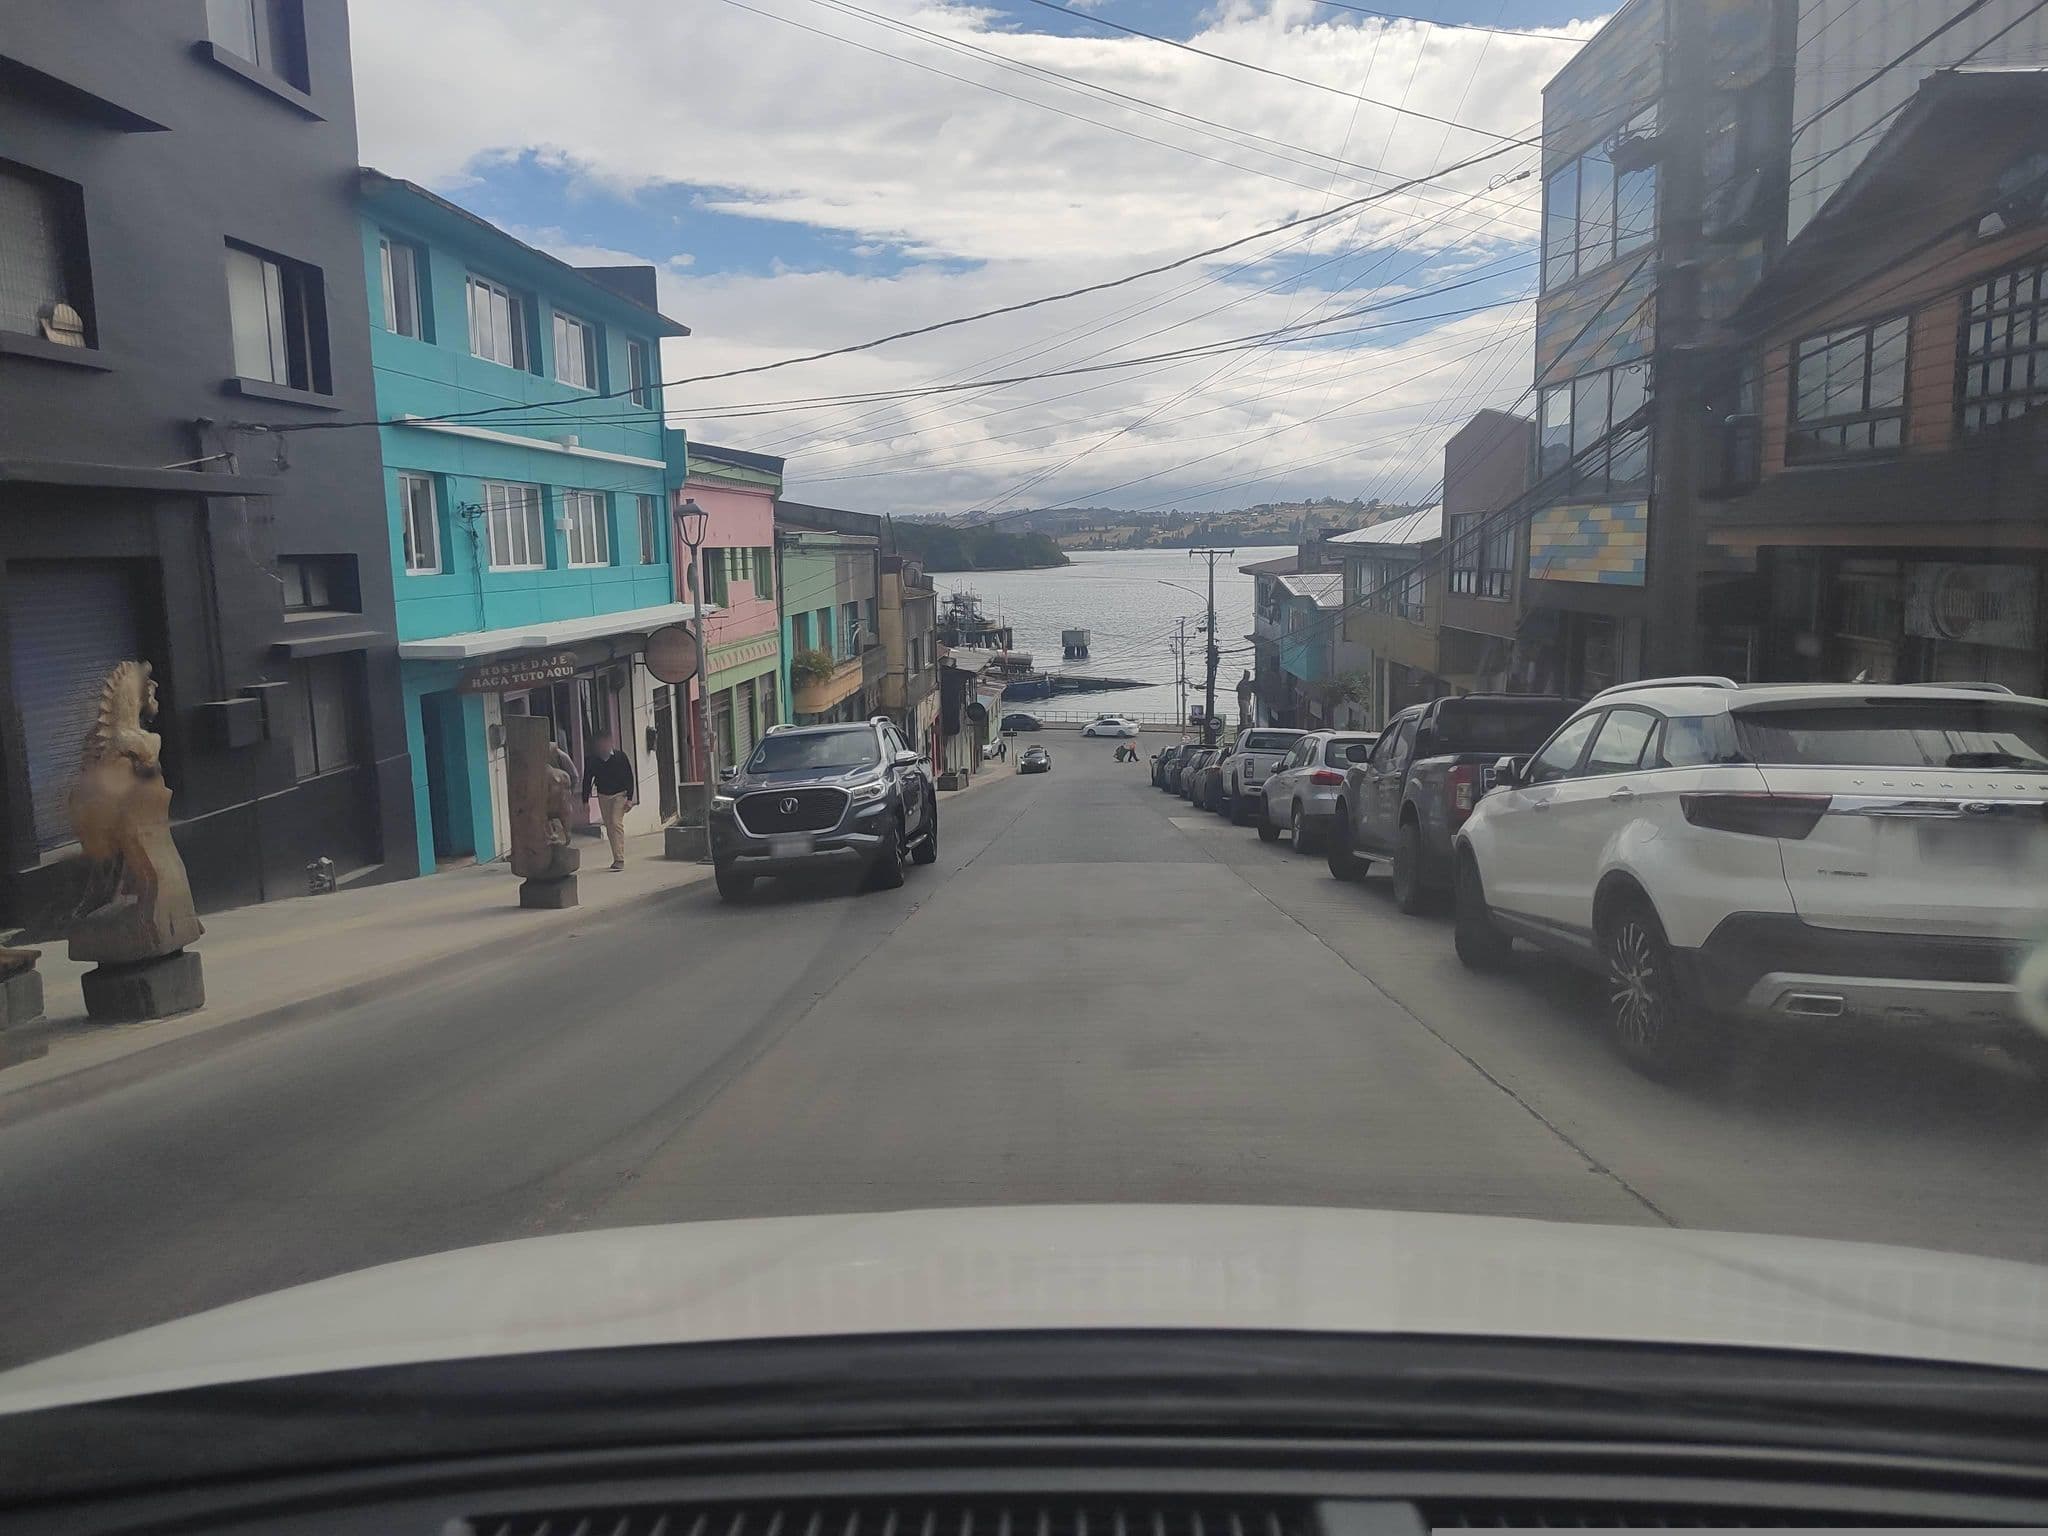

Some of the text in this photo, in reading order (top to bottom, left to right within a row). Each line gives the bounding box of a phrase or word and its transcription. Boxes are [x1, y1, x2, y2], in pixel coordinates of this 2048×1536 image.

[480, 655, 568, 676] HOSPEDAJE
[472, 667, 574, 688] HAGA TUTO AQUI
